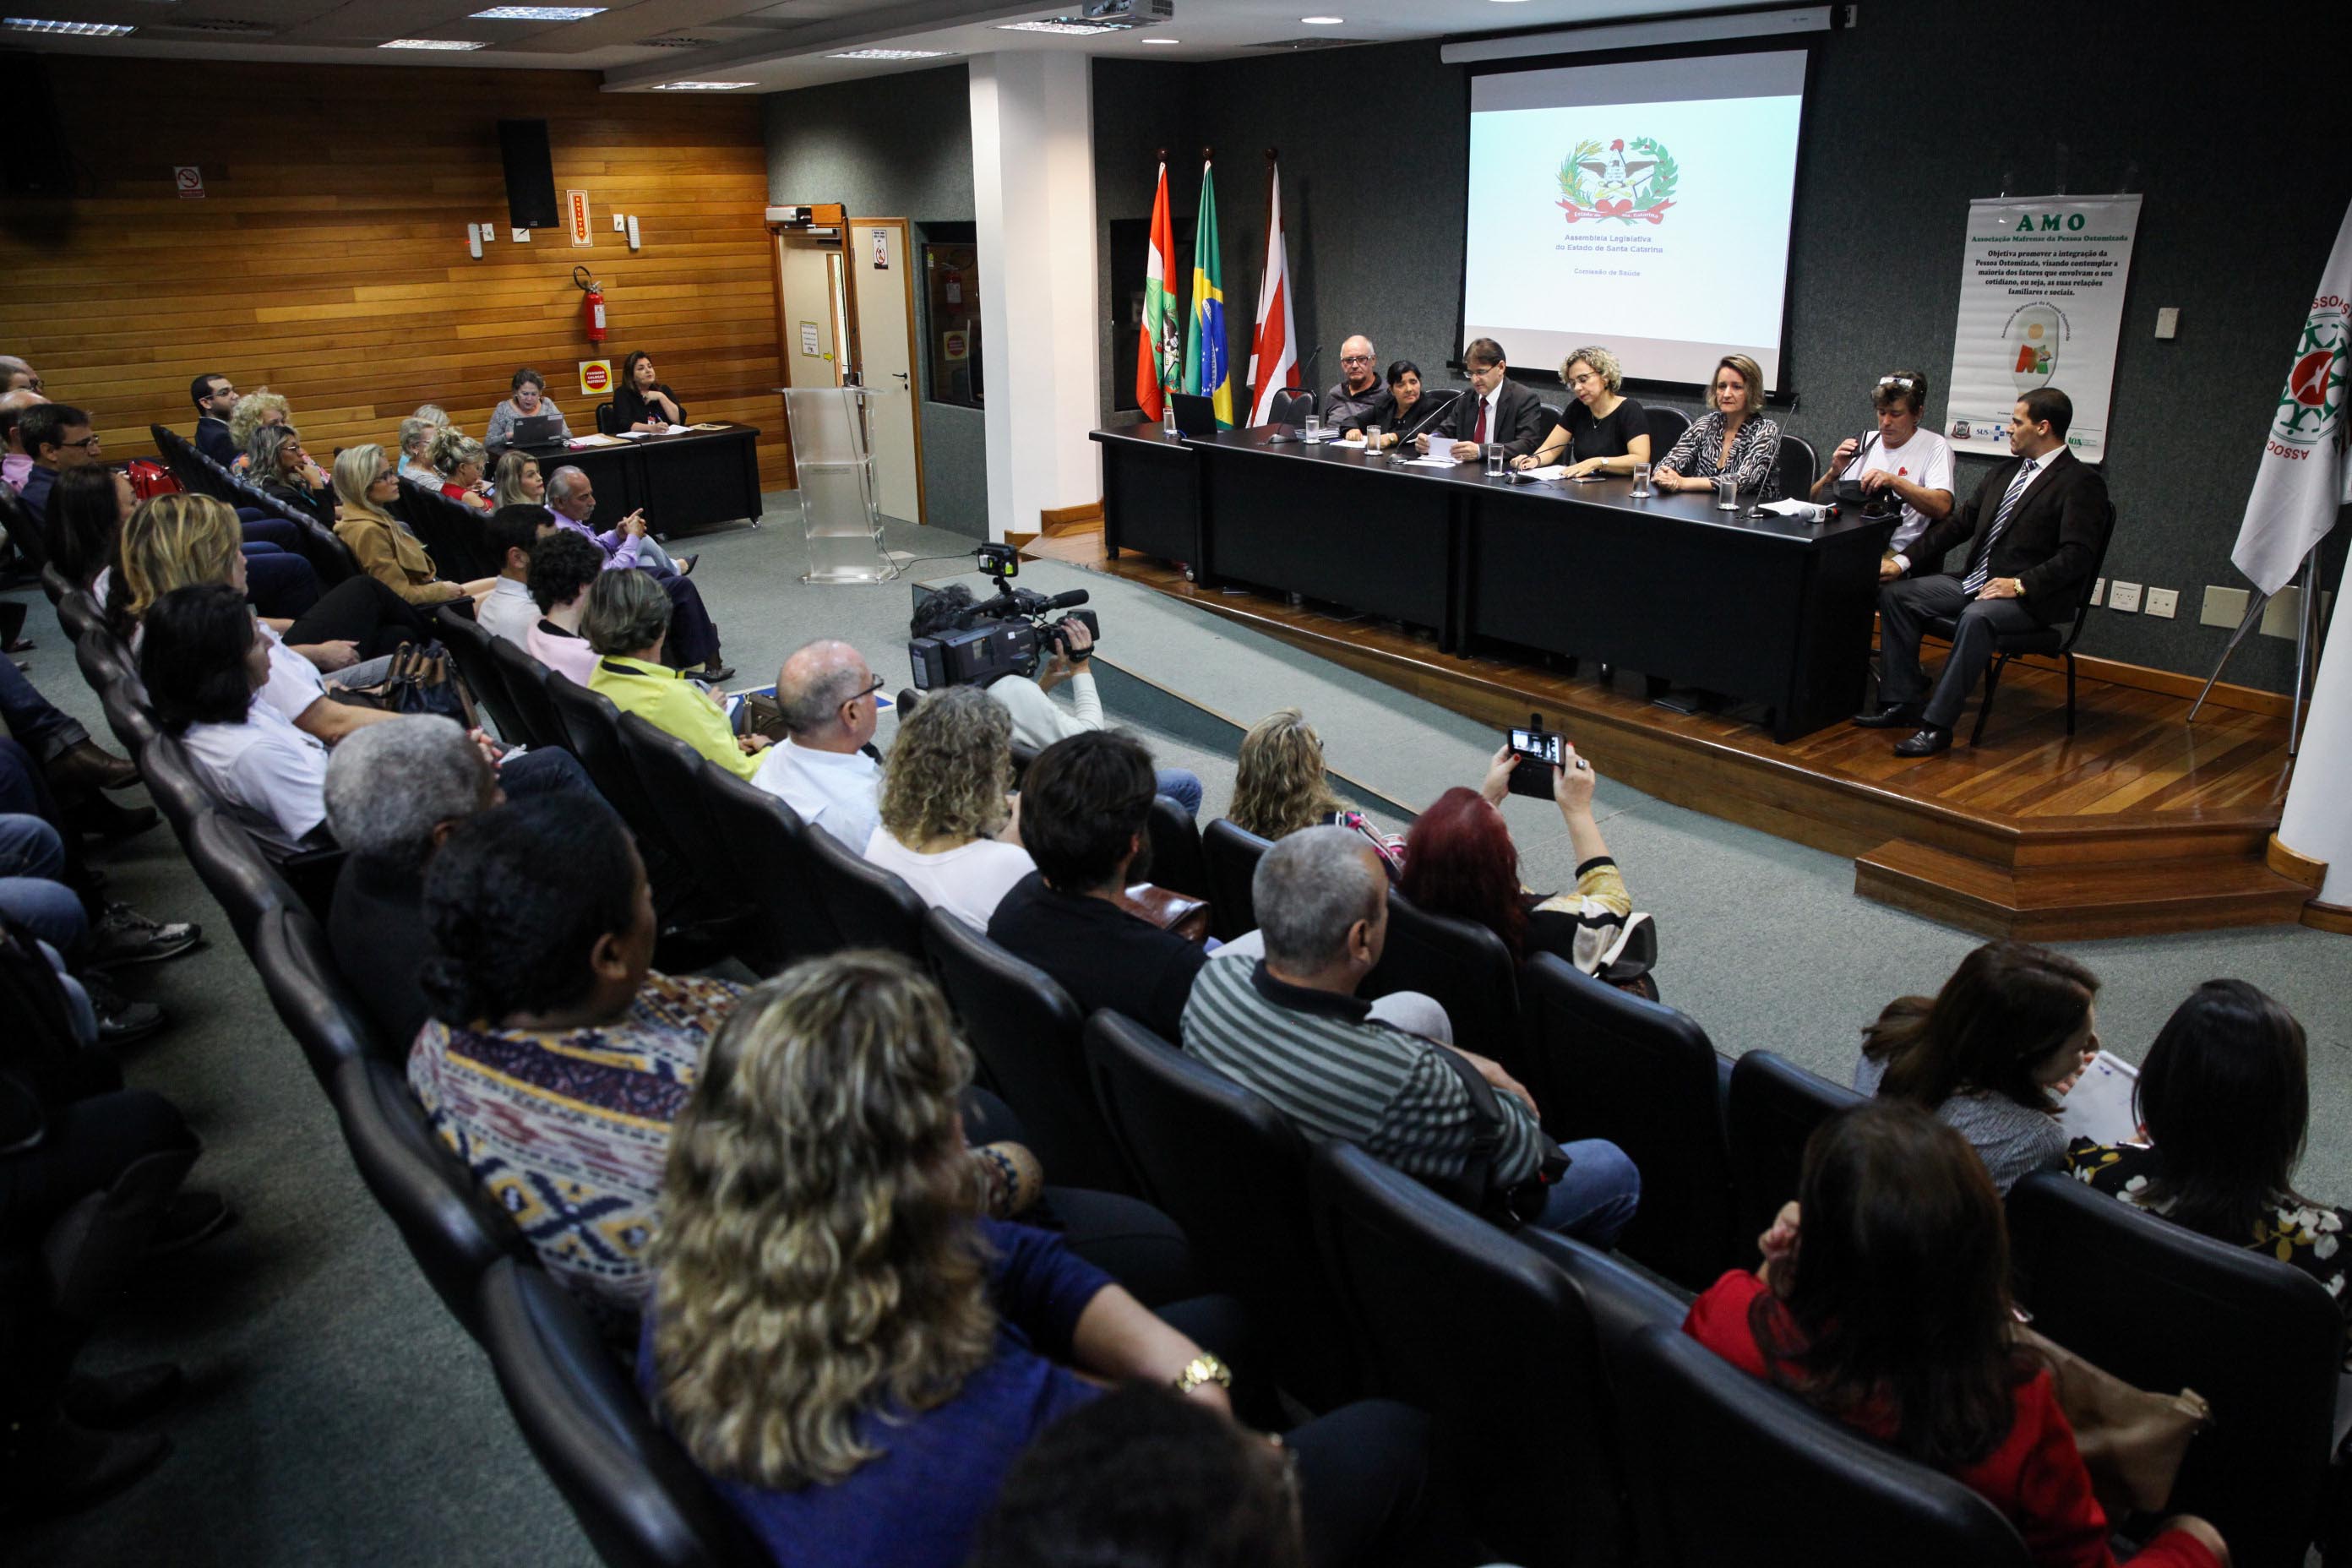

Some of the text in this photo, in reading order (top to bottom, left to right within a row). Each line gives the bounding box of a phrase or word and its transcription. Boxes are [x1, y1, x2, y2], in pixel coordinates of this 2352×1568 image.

[575, 197, 585, 237] EXTINTOR
[1609, 235, 1652, 243] Legislativa
[1988, 250, 2017, 259] Objetiva
[2059, 250, 2097, 259] integração
[2071, 259, 2113, 268] contemplar
[2073, 279, 2103, 287] relações
